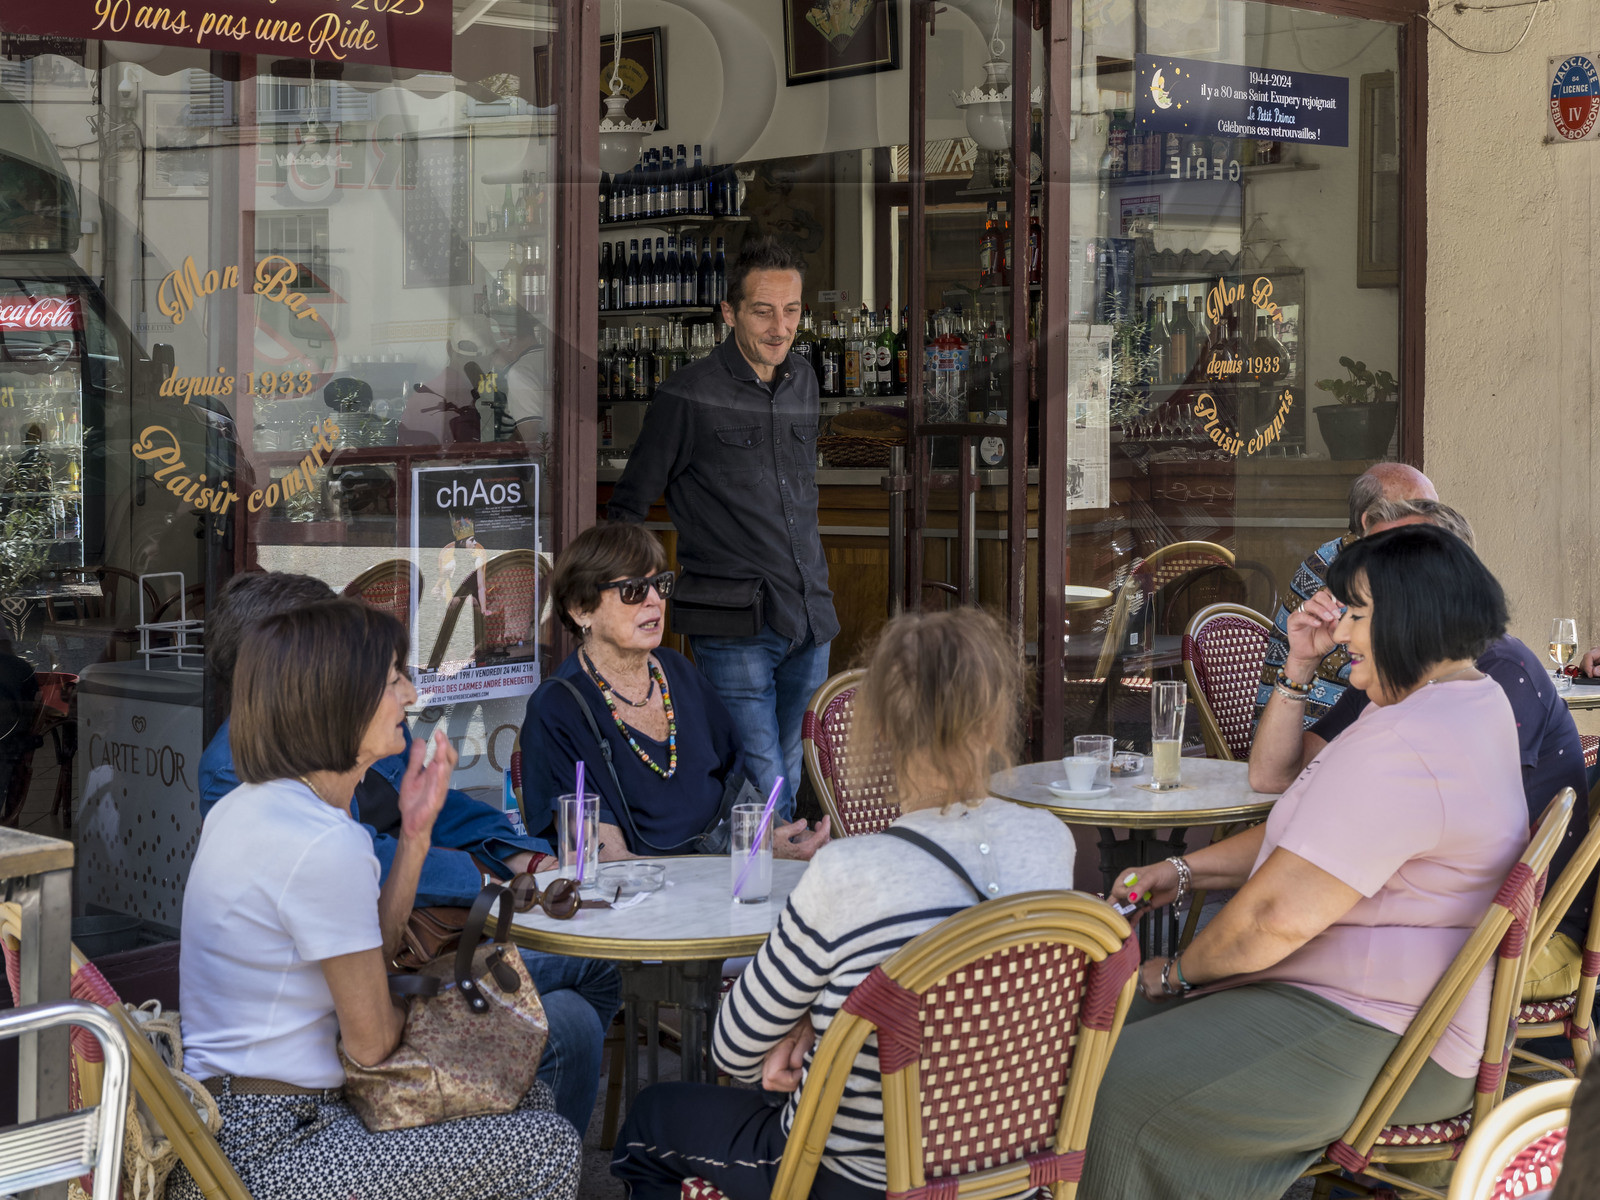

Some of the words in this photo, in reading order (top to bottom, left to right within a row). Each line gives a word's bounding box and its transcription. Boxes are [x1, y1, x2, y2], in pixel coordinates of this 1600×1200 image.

[196, 9, 251, 44] pas
[256, 17, 304, 44] une
[308, 13, 378, 60] Ride
[1249, 71, 1293, 88] 1944-2024
[1553, 57, 1598, 87] VAUCLUSE
[1201, 84, 1206, 96] il
[1207, 87, 1213, 100] y
[1214, 89, 1220, 97] a
[1221, 86, 1232, 99] 80
[1234, 90, 1247, 100] ans
[1248, 88, 1269, 102] Saint
[1270, 91, 1301, 109] Exupery
[1302, 95, 1337, 111] rejoignait
[1562, 84, 1588, 94] LICENCE
[1247, 106, 1255, 121] Le
[1257, 106, 1272, 122] Petit
[1274, 108, 1296, 125] Prince
[1551, 100, 1564, 127] DEBIT
[1568, 97, 1600, 139] BOISSONS
[1568, 106, 1582, 121] IV
[1217, 119, 1256, 135] Célébrons
[1257, 126, 1270, 136] ces
[1271, 126, 1316, 140] retrouvailles
[158, 255, 239, 325] Mon
[253, 255, 319, 322] Bar
[1206, 276, 1246, 326] Mon
[1251, 276, 1284, 324] Bar
[0, 297, 80, 328] ca-Cola
[1206, 353, 1243, 379] depuis
[1247, 356, 1281, 374] 1933
[158, 366, 235, 404] depuis
[246, 371, 313, 395] 1933
[1194, 392, 1244, 456] Plaisir
[1247, 389, 1294, 455] compris
[132, 425, 240, 514] Plaisir
[247, 416, 341, 513] compris
[436, 478, 521, 508] chAos
[420, 674, 436, 684] JEUDI
[460, 669, 470, 679] 19H
[475, 666, 502, 678] VENDREDI
[503, 665, 510, 674] 24
[511, 664, 521, 673] MAI
[523, 663, 534, 672] 21H
[447, 683, 457, 693] DES
[458, 680, 482, 691] CARMES
[483, 677, 501, 689] ANDRÉ
[503, 675, 534, 686] BENEDETTO
